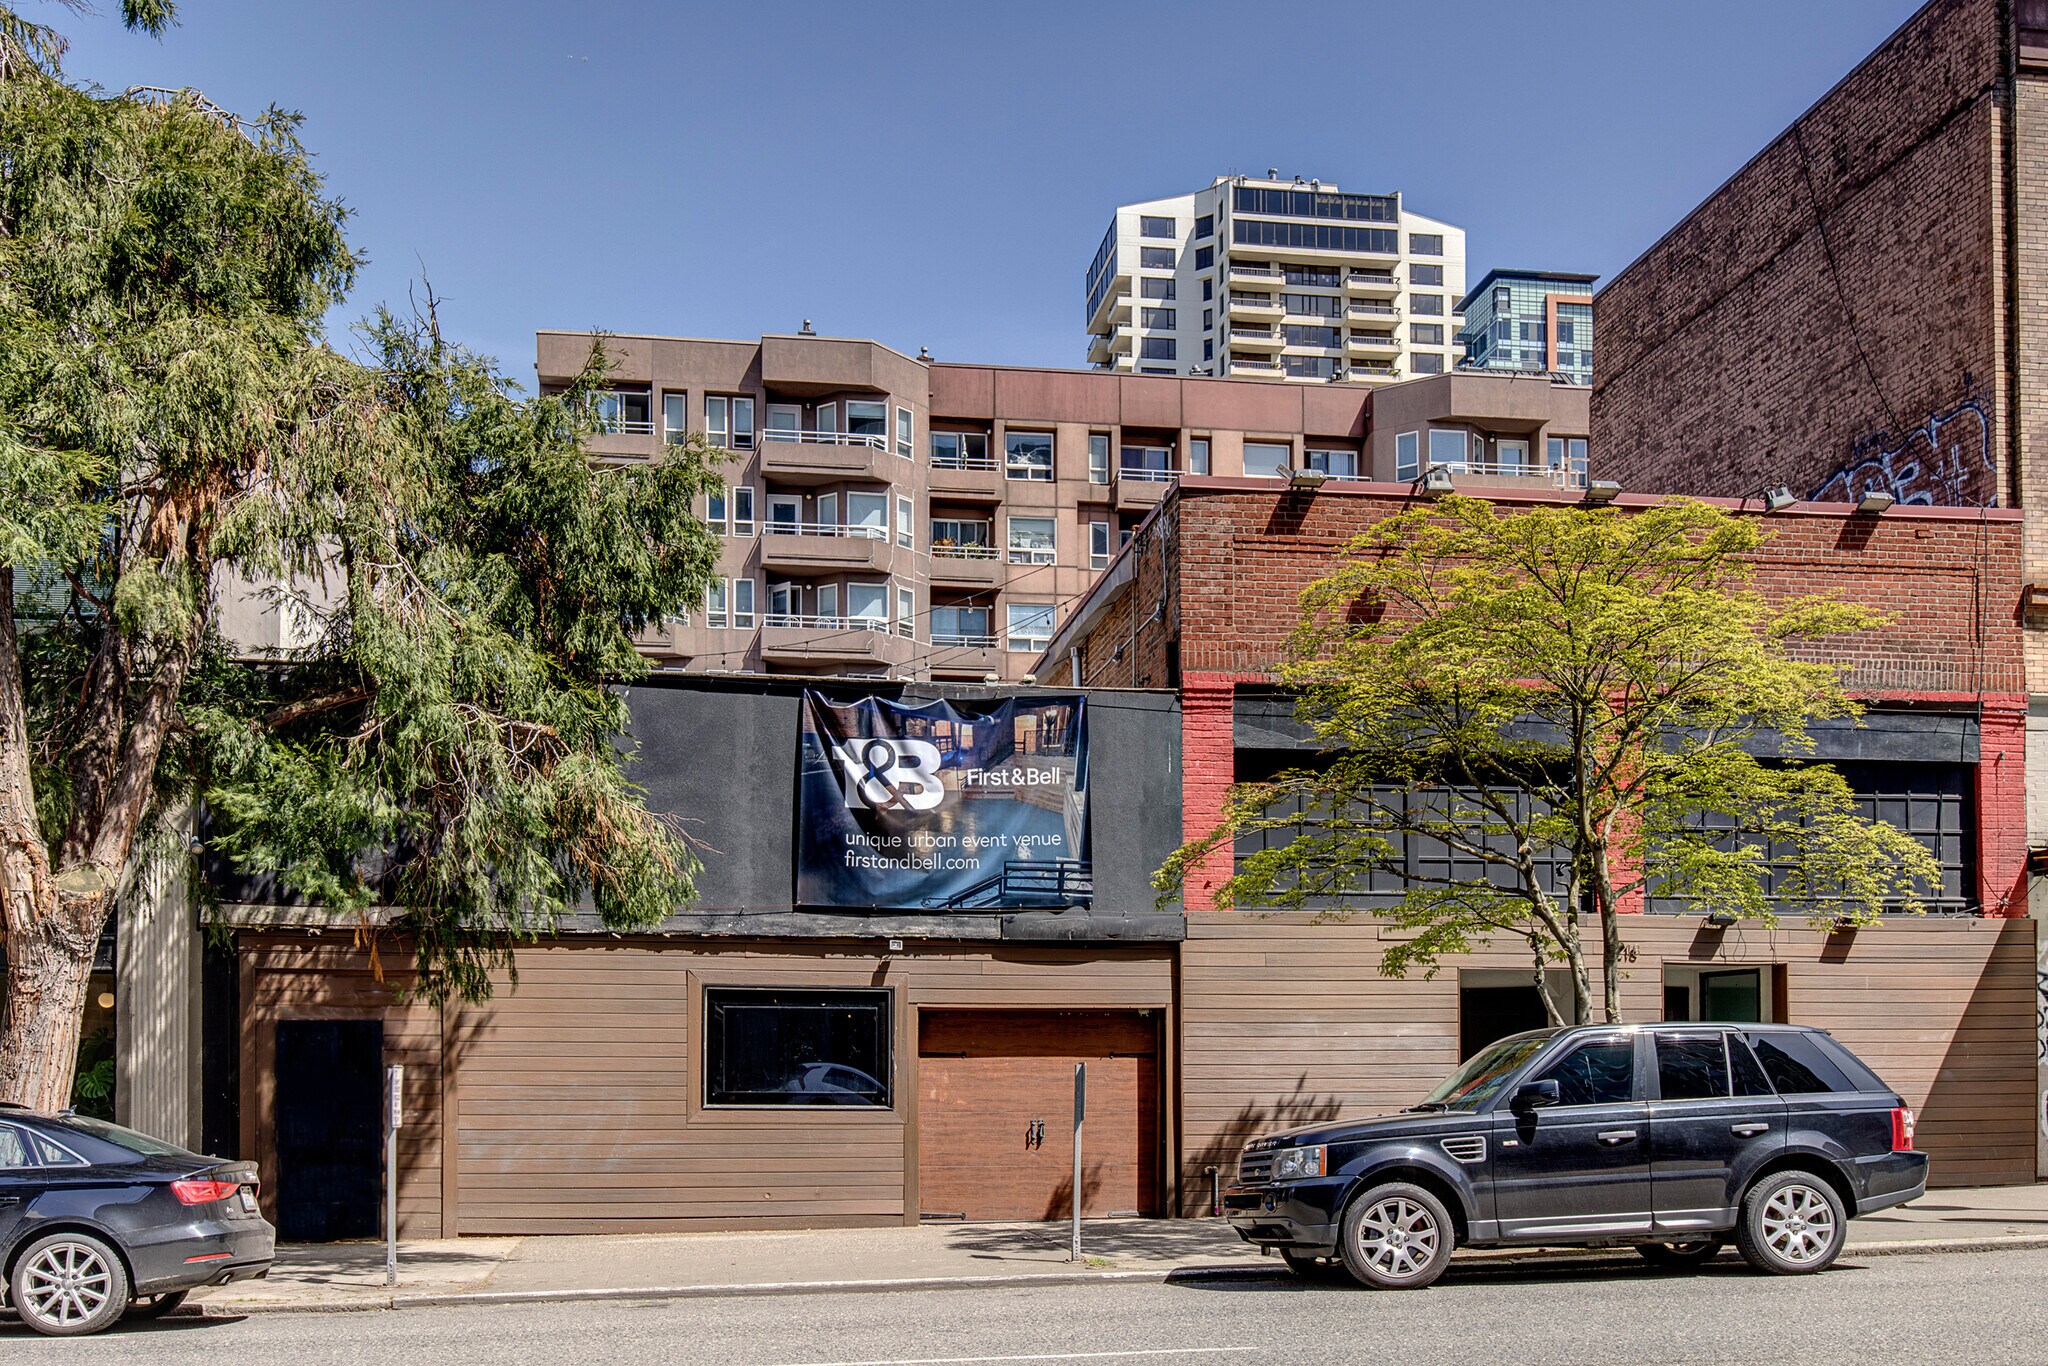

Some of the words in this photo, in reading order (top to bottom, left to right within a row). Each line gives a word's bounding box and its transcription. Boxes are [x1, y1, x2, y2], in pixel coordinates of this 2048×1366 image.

[845, 832, 902, 851] unique
[907, 831, 957, 848] urban
[962, 834, 1008, 848] event
[1012, 834, 1062, 847] venue
[844, 850, 980, 870] firstandbell.com
